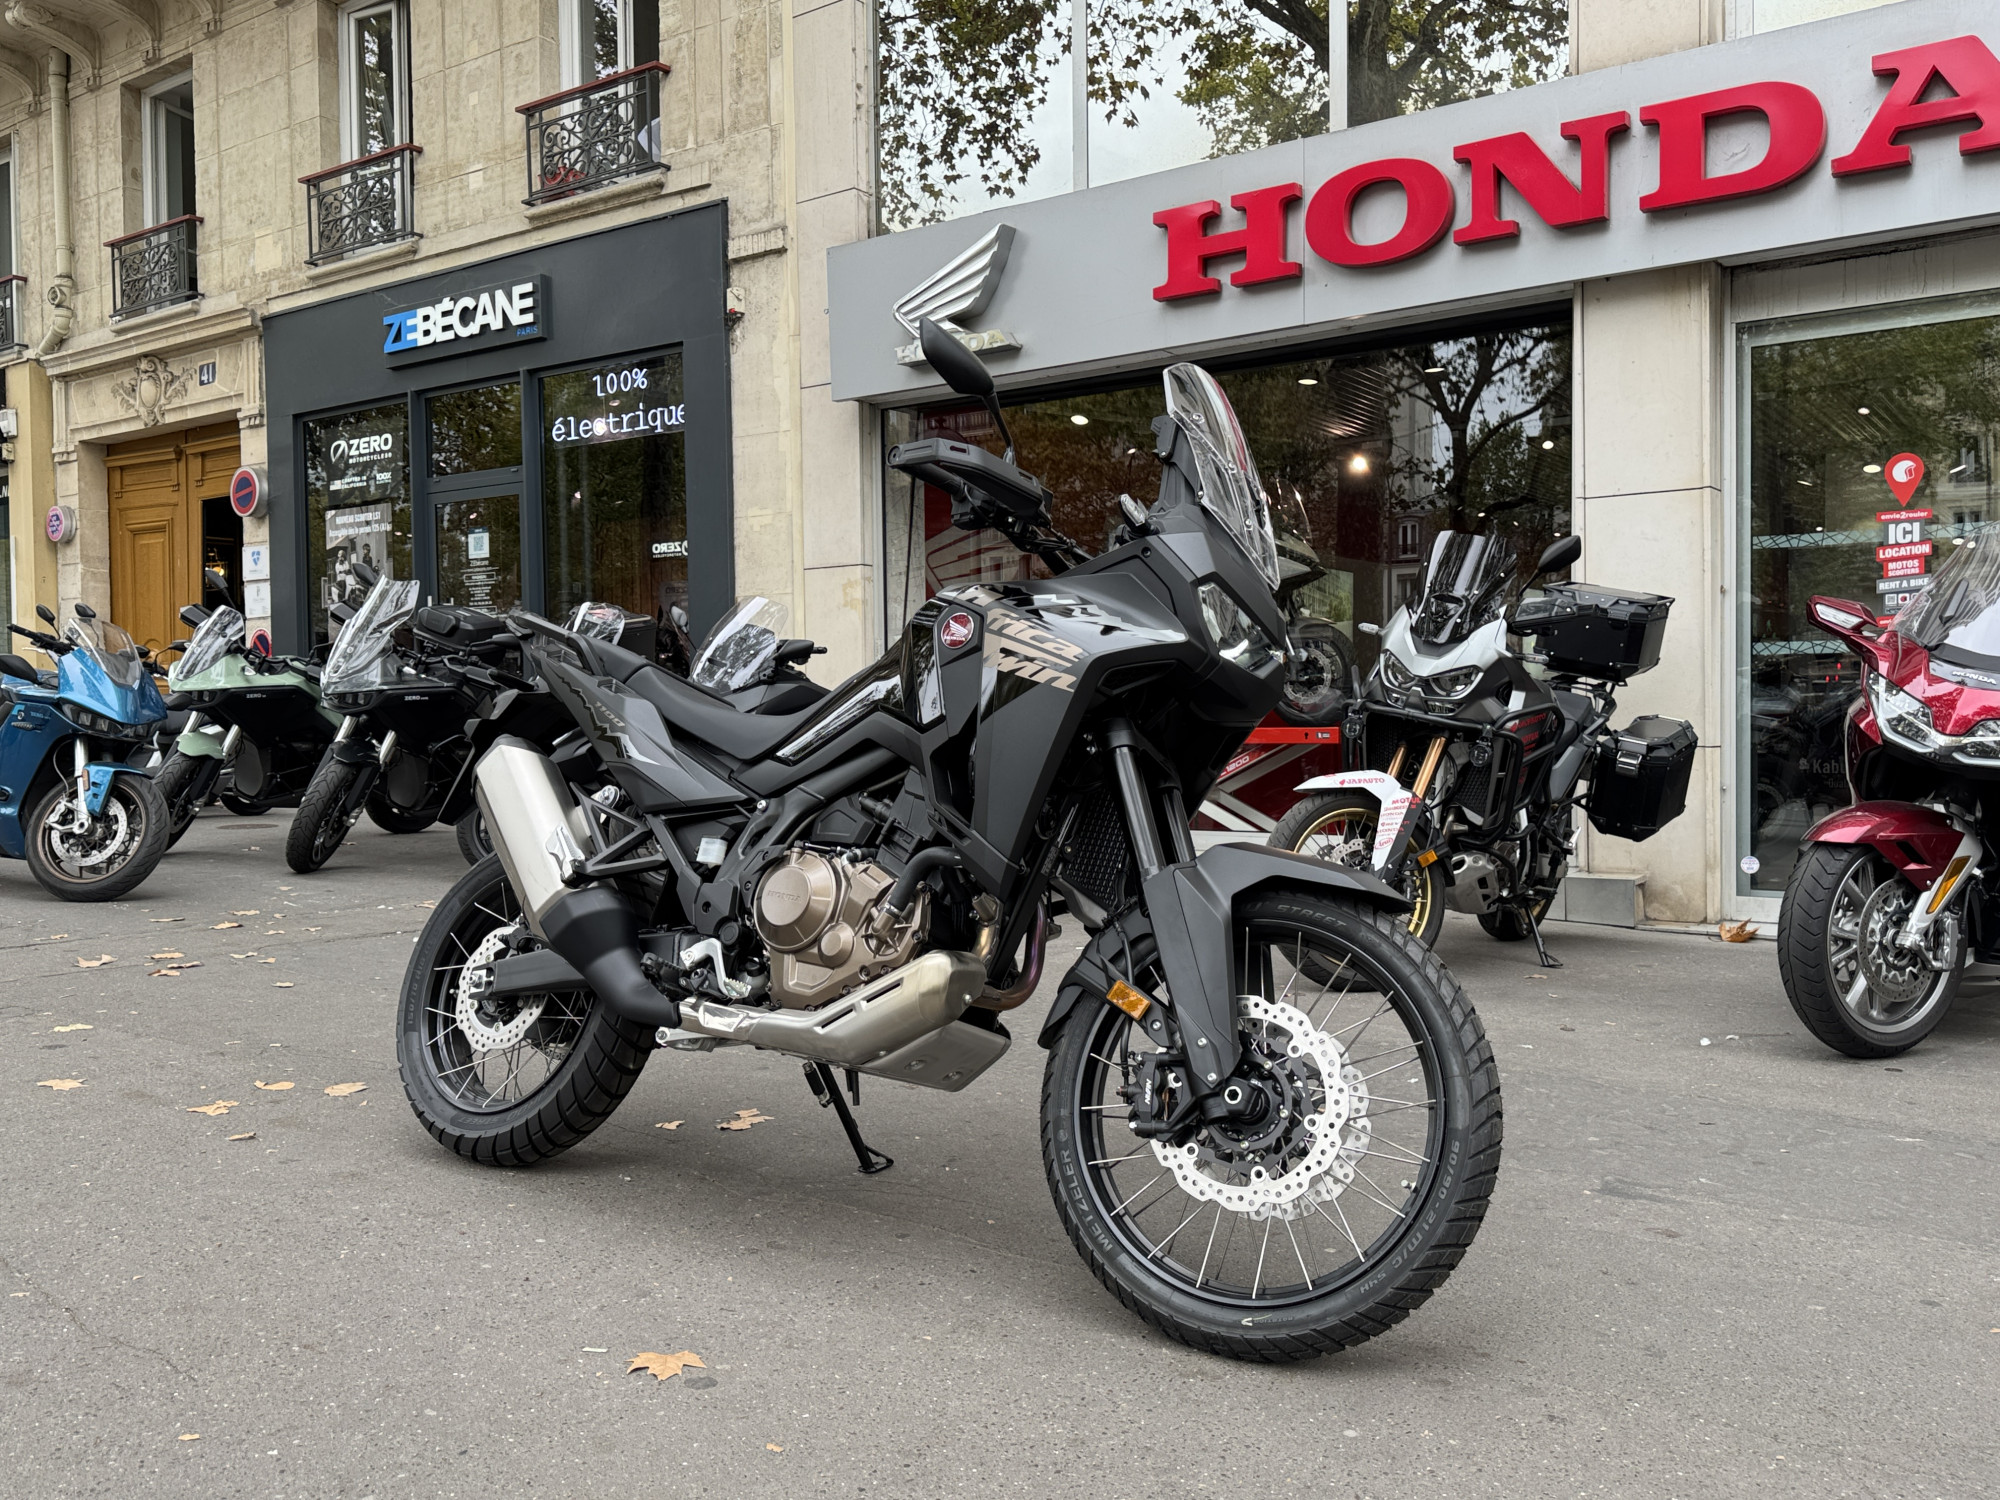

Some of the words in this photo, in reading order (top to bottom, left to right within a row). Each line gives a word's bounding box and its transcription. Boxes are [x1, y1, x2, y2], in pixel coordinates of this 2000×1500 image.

[1153, 34, 2000, 302] HONDA
[383, 281, 534, 354] ZEBÉCANE
[516, 325, 539, 337] PARIS
[200, 363, 213, 384] 41
[592, 367, 648, 397] 100%
[551, 403, 685, 442] électrique
[349, 433, 393, 456] ZERO
[375, 472, 392, 480] 100%
[1880, 510, 1929, 520] envie2rouler
[1888, 522, 1920, 544] ICI
[1879, 544, 1930, 559] LOCATION
[1888, 559, 1920, 570] MOTOS
[1888, 567, 1920, 577] SCOOTERS
[1879, 581, 1900, 591] RENT
[1902, 579, 1908, 587] A
[1910, 577, 1930, 587] BIKE
[1951, 671, 1997, 685] HONDA
[1346, 777, 1385, 785] JAPAUTO
[1391, 797, 1421, 806] MOTUL
[1276, 904, 1347, 928] STREET
[1438, 1139, 1460, 1200] 90/90
[1059, 1149, 1113, 1252] METZELER
